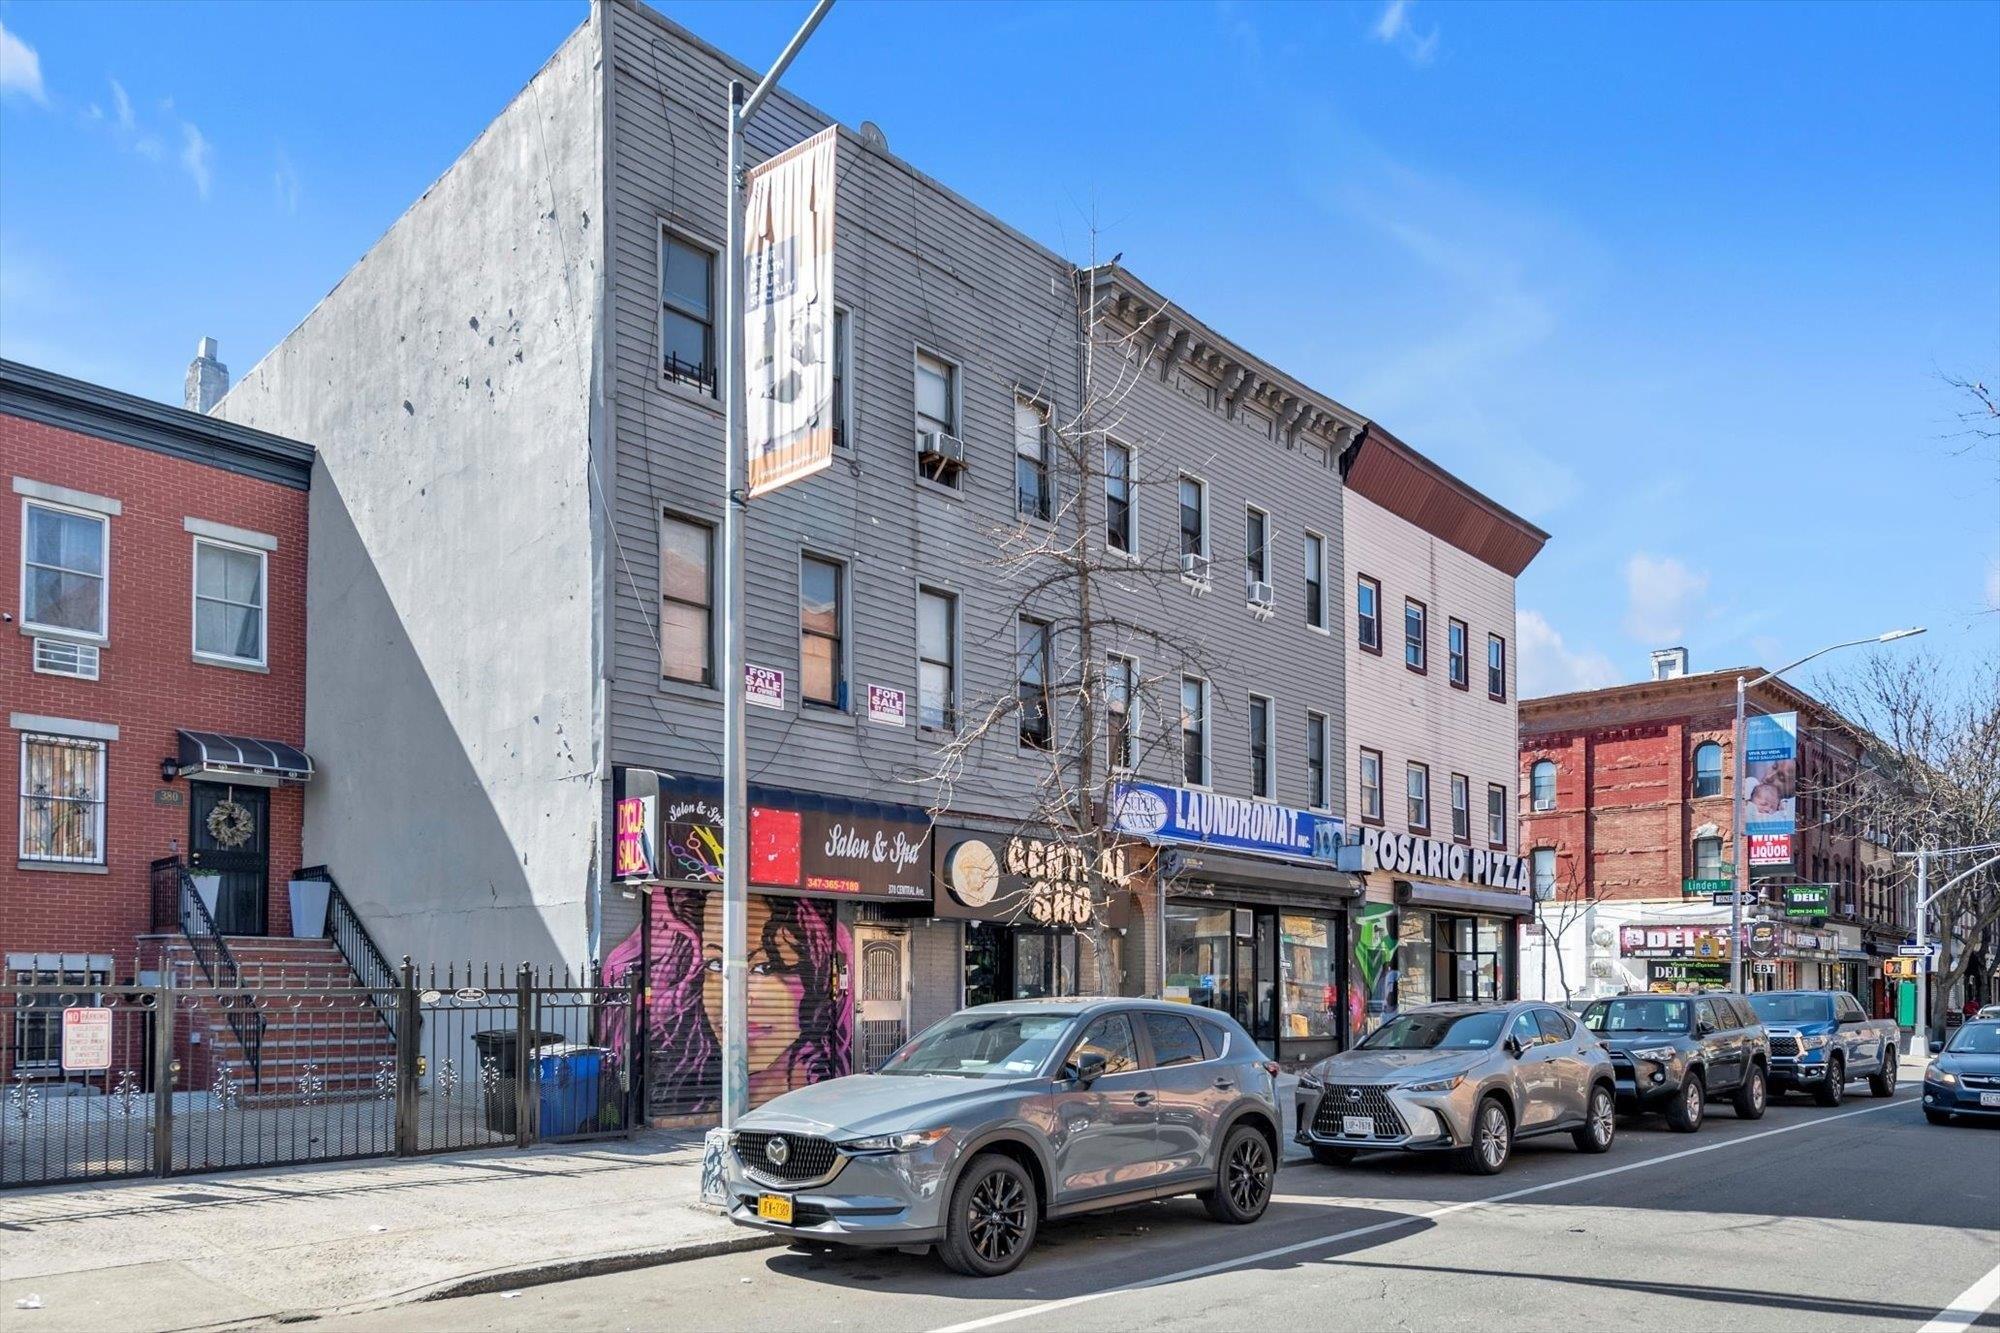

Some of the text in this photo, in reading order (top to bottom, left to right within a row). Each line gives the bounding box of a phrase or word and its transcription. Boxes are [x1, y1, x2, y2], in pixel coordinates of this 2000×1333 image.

[749, 667, 776, 681] FOR
[745, 674, 781, 692] SALE
[747, 685, 756, 693] BY
[756, 687, 778, 697] OWNER
[875, 688, 899, 700] FOR
[871, 696, 903, 710] SALE
[883, 706, 900, 715] OWNER
[161, 791, 179, 801] 380
[669, 801, 695, 821] Salon
[696, 801, 706, 815] &
[1175, 789, 1299, 846] LAUNDROMAT
[824, 823, 919, 874] Salon & Spa
[1751, 844, 1789, 858] LIQUOR
[1364, 827, 1531, 891] ROSARIO PIZZA
[807, 877, 859, 893] 347-365-7189
[896, 885, 915, 896] CENTRAL
[1688, 881, 1718, 890] Linden
[1793, 893, 1820, 902] DELI
[1654, 966, 1687, 979] DELI
[1754, 964, 1775, 972] EBT
[67, 1011, 79, 1023] NO
